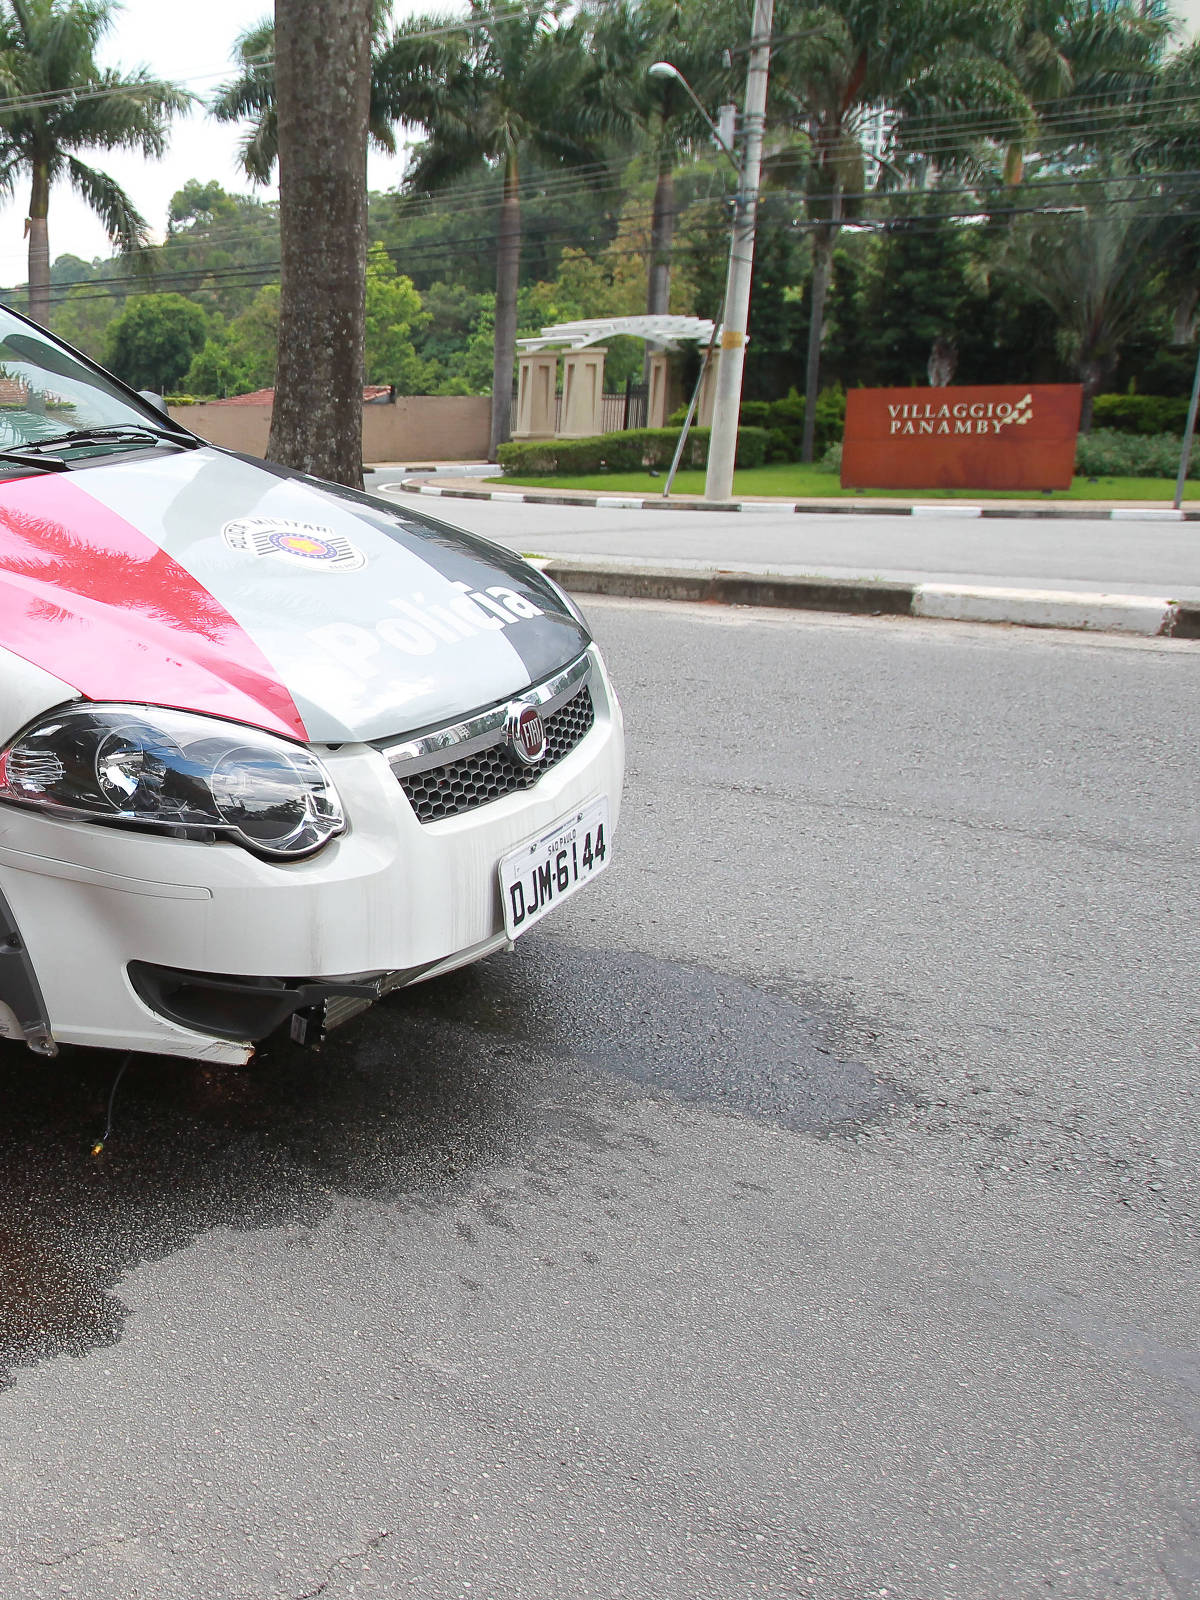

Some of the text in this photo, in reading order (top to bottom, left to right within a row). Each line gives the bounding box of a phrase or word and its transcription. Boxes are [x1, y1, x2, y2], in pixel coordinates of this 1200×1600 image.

[888, 402, 1013, 419] VILLAGGIO
[890, 420, 1003, 435] PANAMBY
[522, 717, 541, 748] FIAT
[560, 829, 576, 845] PAULO
